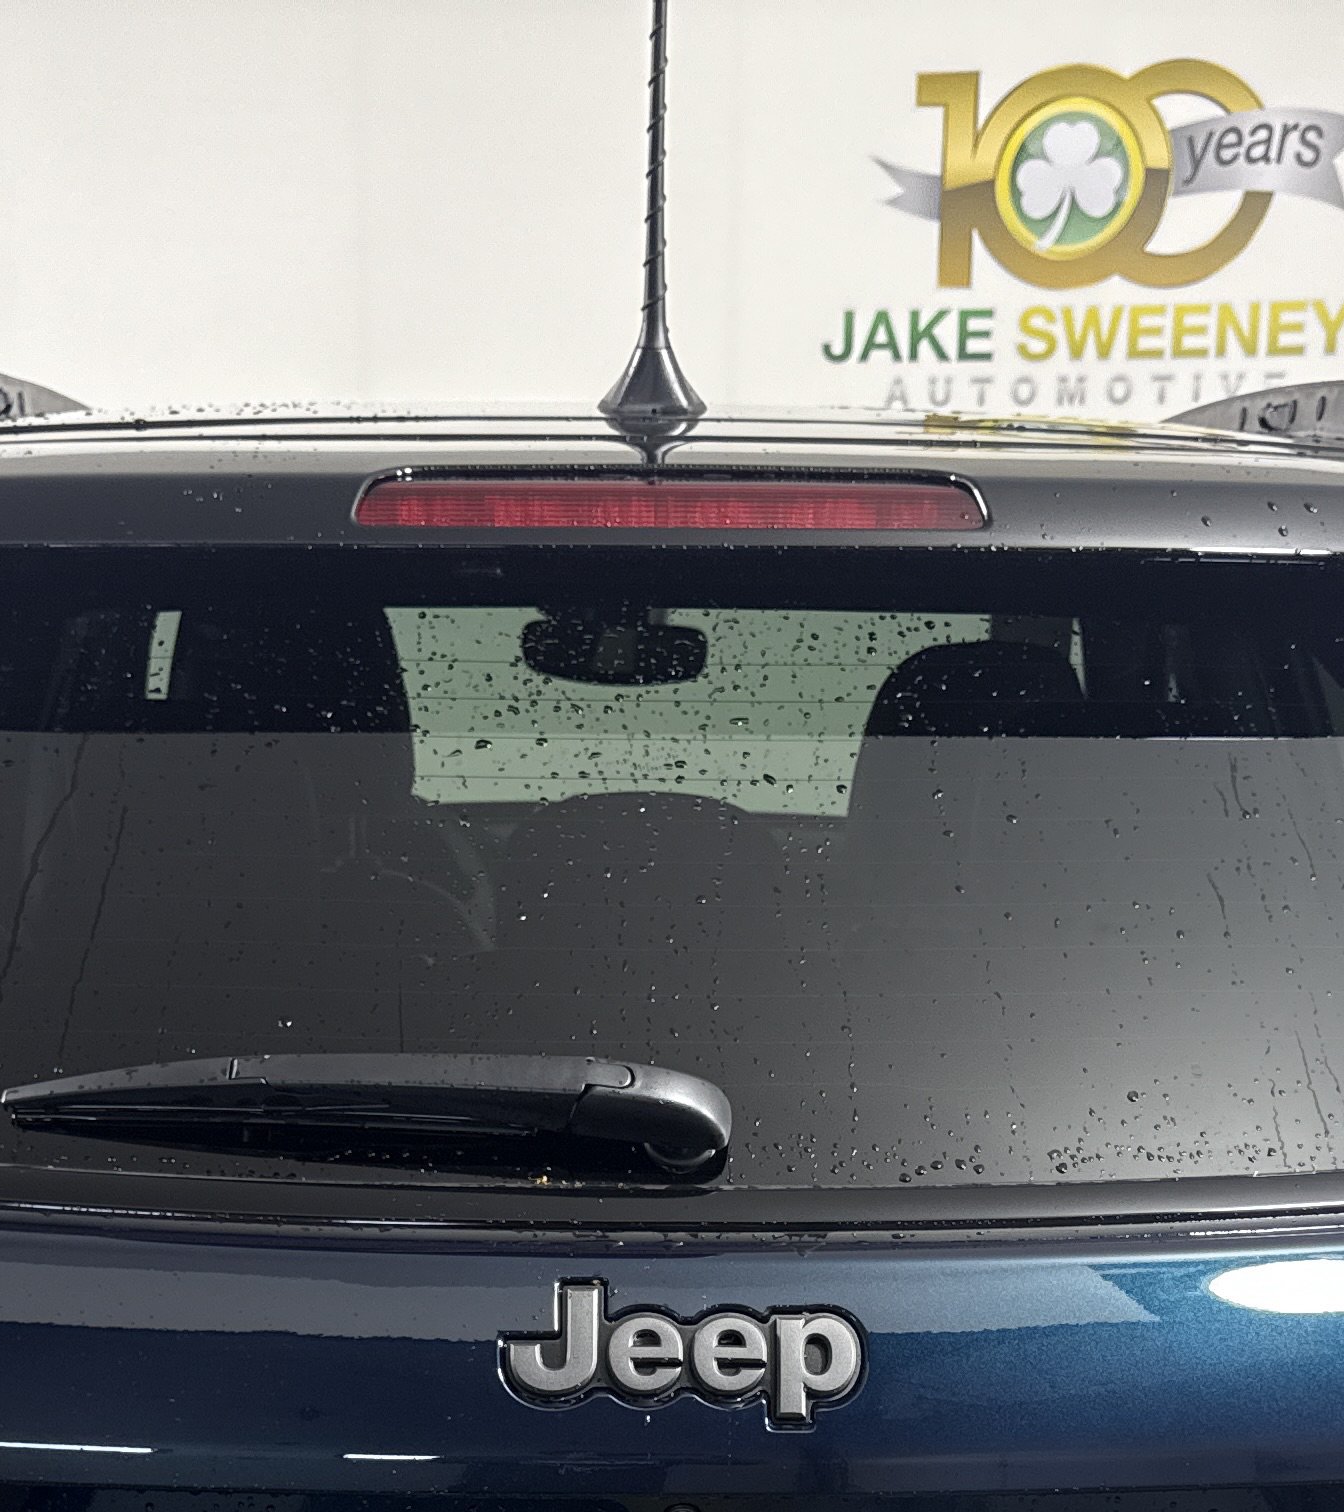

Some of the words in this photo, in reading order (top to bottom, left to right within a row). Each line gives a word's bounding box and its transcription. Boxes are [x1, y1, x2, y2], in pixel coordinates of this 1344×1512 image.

[916, 58, 1273, 289] 100
[1182, 122, 1324, 187] years
[822, 308, 995, 363] JAKE
[884, 372, 1288, 409] AUTOMOTIV
[504, 1280, 865, 1423] Jeep
